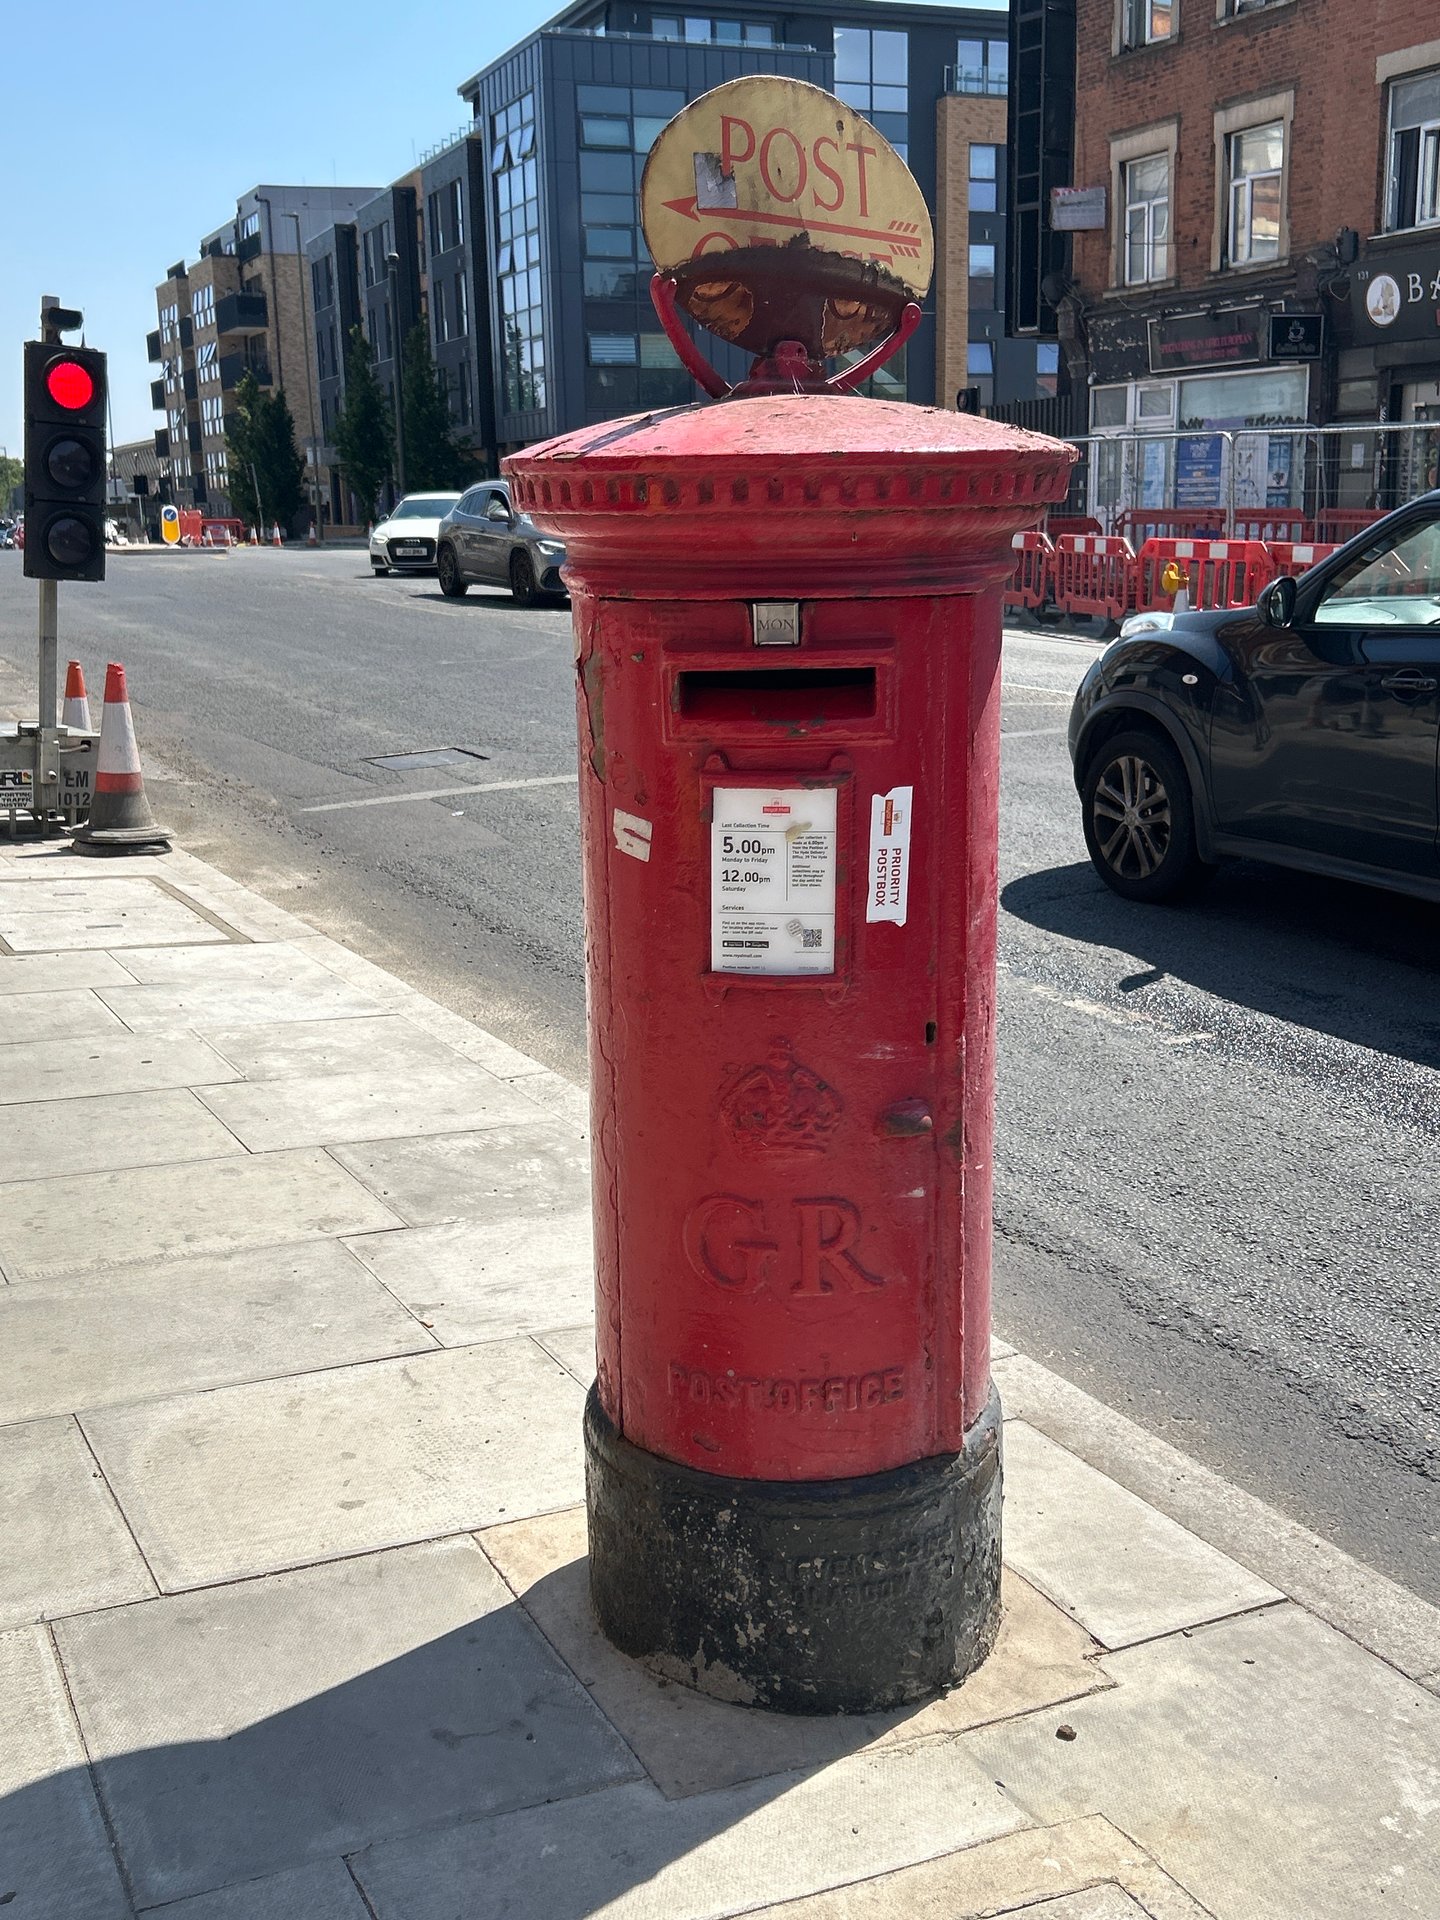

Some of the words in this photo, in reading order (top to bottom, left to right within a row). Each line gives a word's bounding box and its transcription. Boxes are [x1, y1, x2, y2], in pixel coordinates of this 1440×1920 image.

[719, 114, 877, 218] POST
[758, 618, 794, 632] MON
[723, 836, 775, 855] 5.00pm
[751, 857, 768, 865] Friday
[722, 869, 771, 884] 12.00pm
[875, 849, 887, 907] POSTBOX
[890, 848, 901, 905] PRIORITY
[668, 1361, 760, 1403] POST
[770, 1365, 905, 1413] OFFICE
